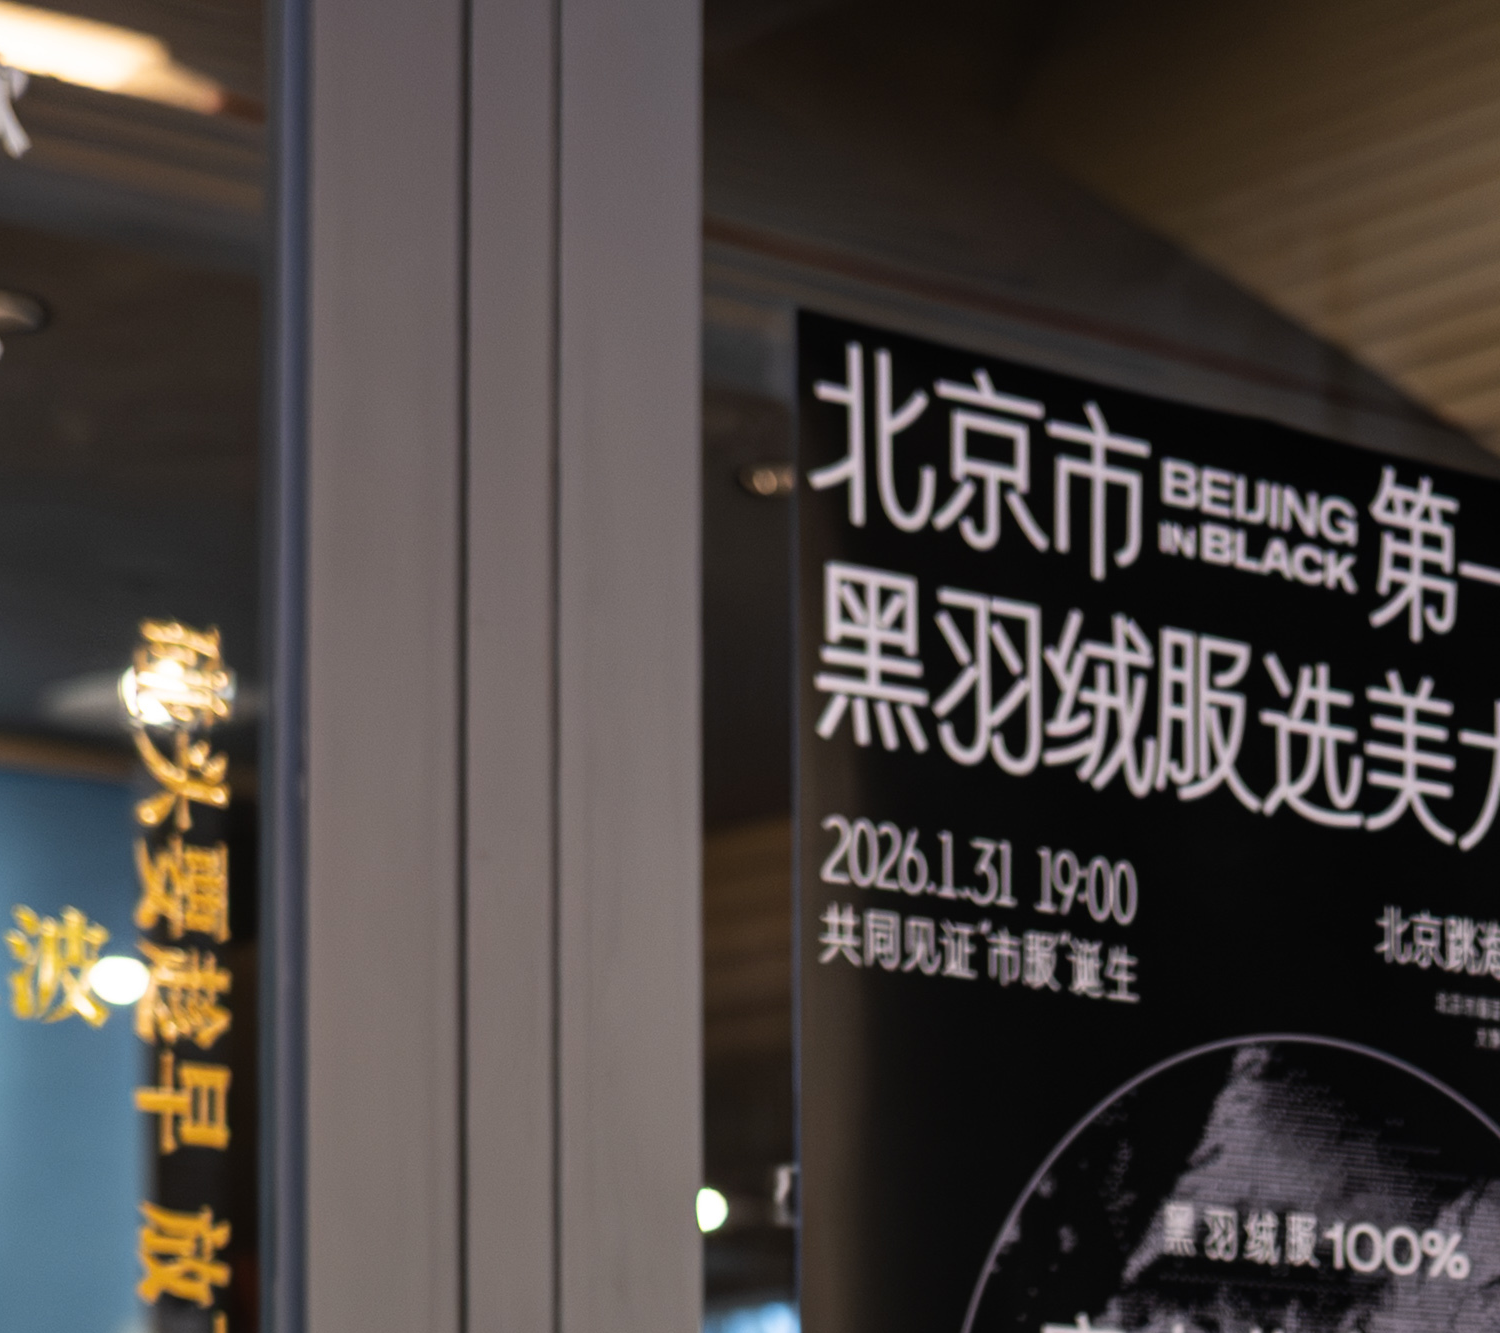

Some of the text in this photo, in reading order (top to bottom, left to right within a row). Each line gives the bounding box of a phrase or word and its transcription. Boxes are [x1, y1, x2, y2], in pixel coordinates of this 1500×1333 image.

[808, 342, 1152, 582] 北京市
[1159, 457, 1360, 547] BEIJING
[1158, 520, 1360, 594] IN BLACK
[820, 814, 1140, 927] 2026.1.31 19:00
[1162, 1200, 1472, 1281] 黑羽绒服 100%
